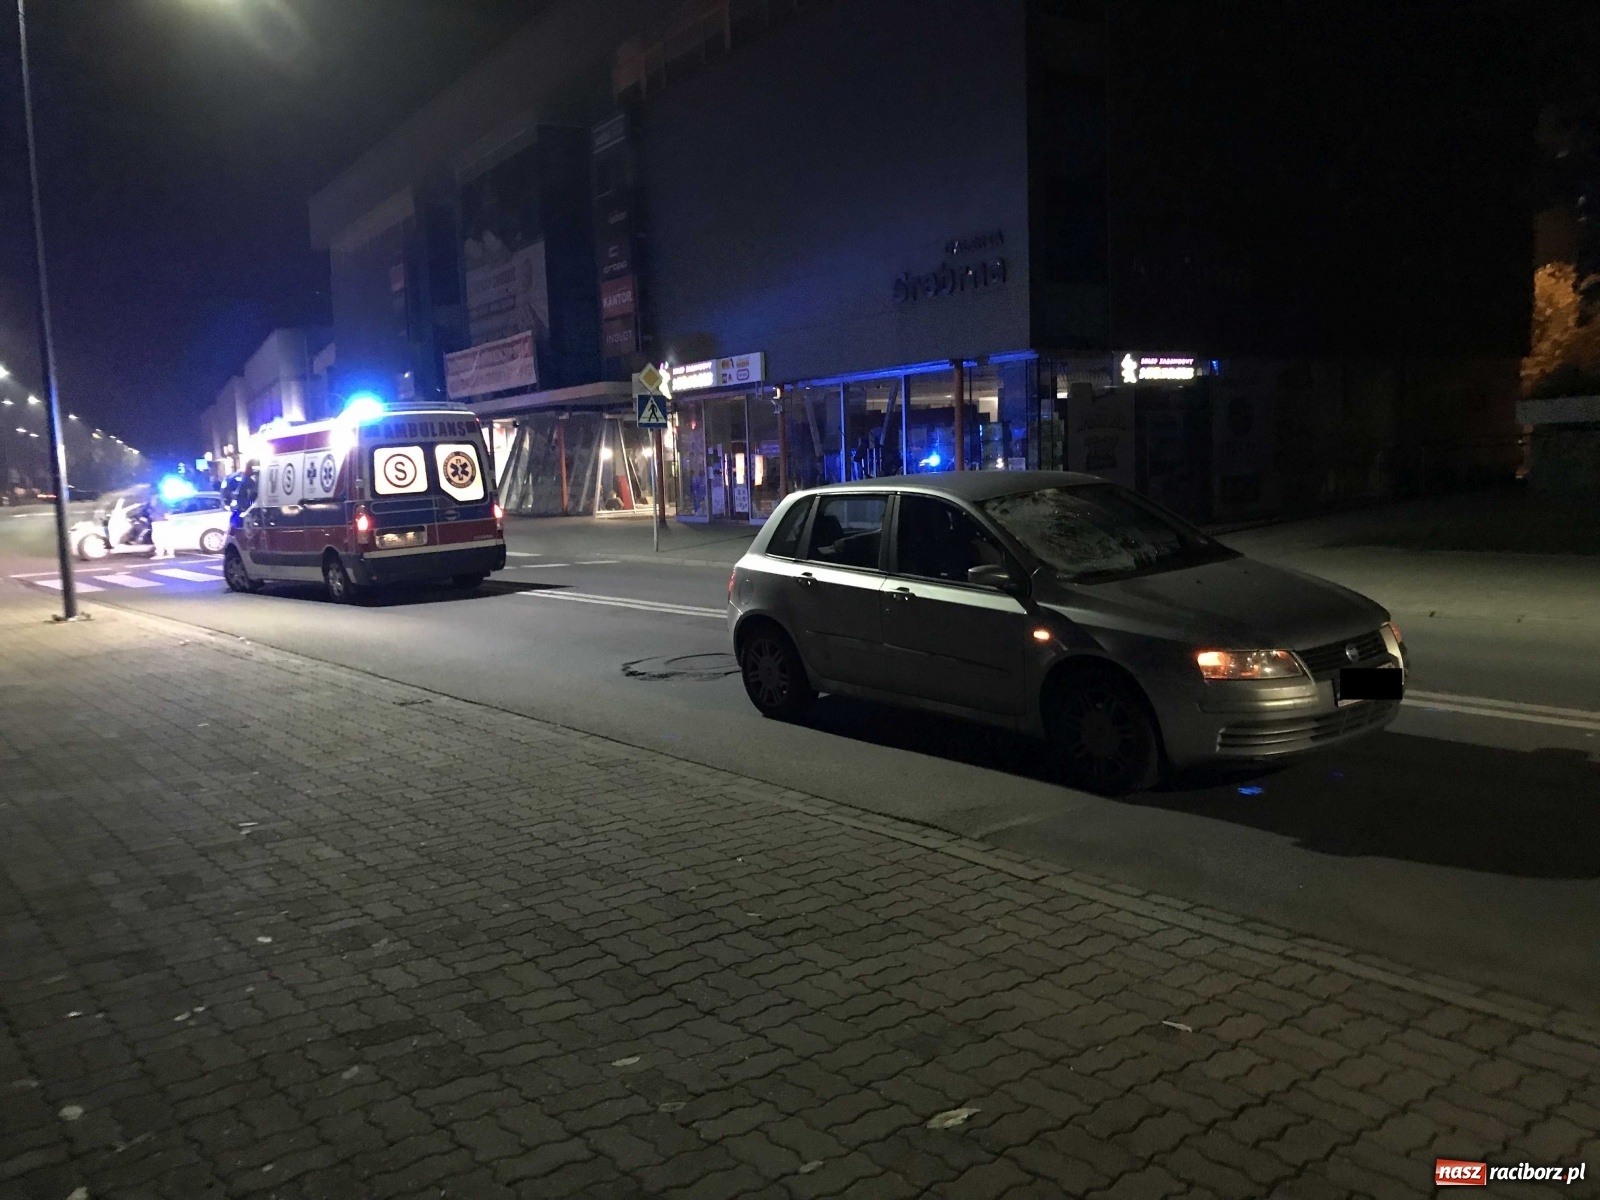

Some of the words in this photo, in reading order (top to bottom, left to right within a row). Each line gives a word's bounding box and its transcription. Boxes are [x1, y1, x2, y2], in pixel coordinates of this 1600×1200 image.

[603, 290, 633, 308] KANTOR
[382, 421, 467, 440] AMBULANS
[394, 461, 408, 482] S
